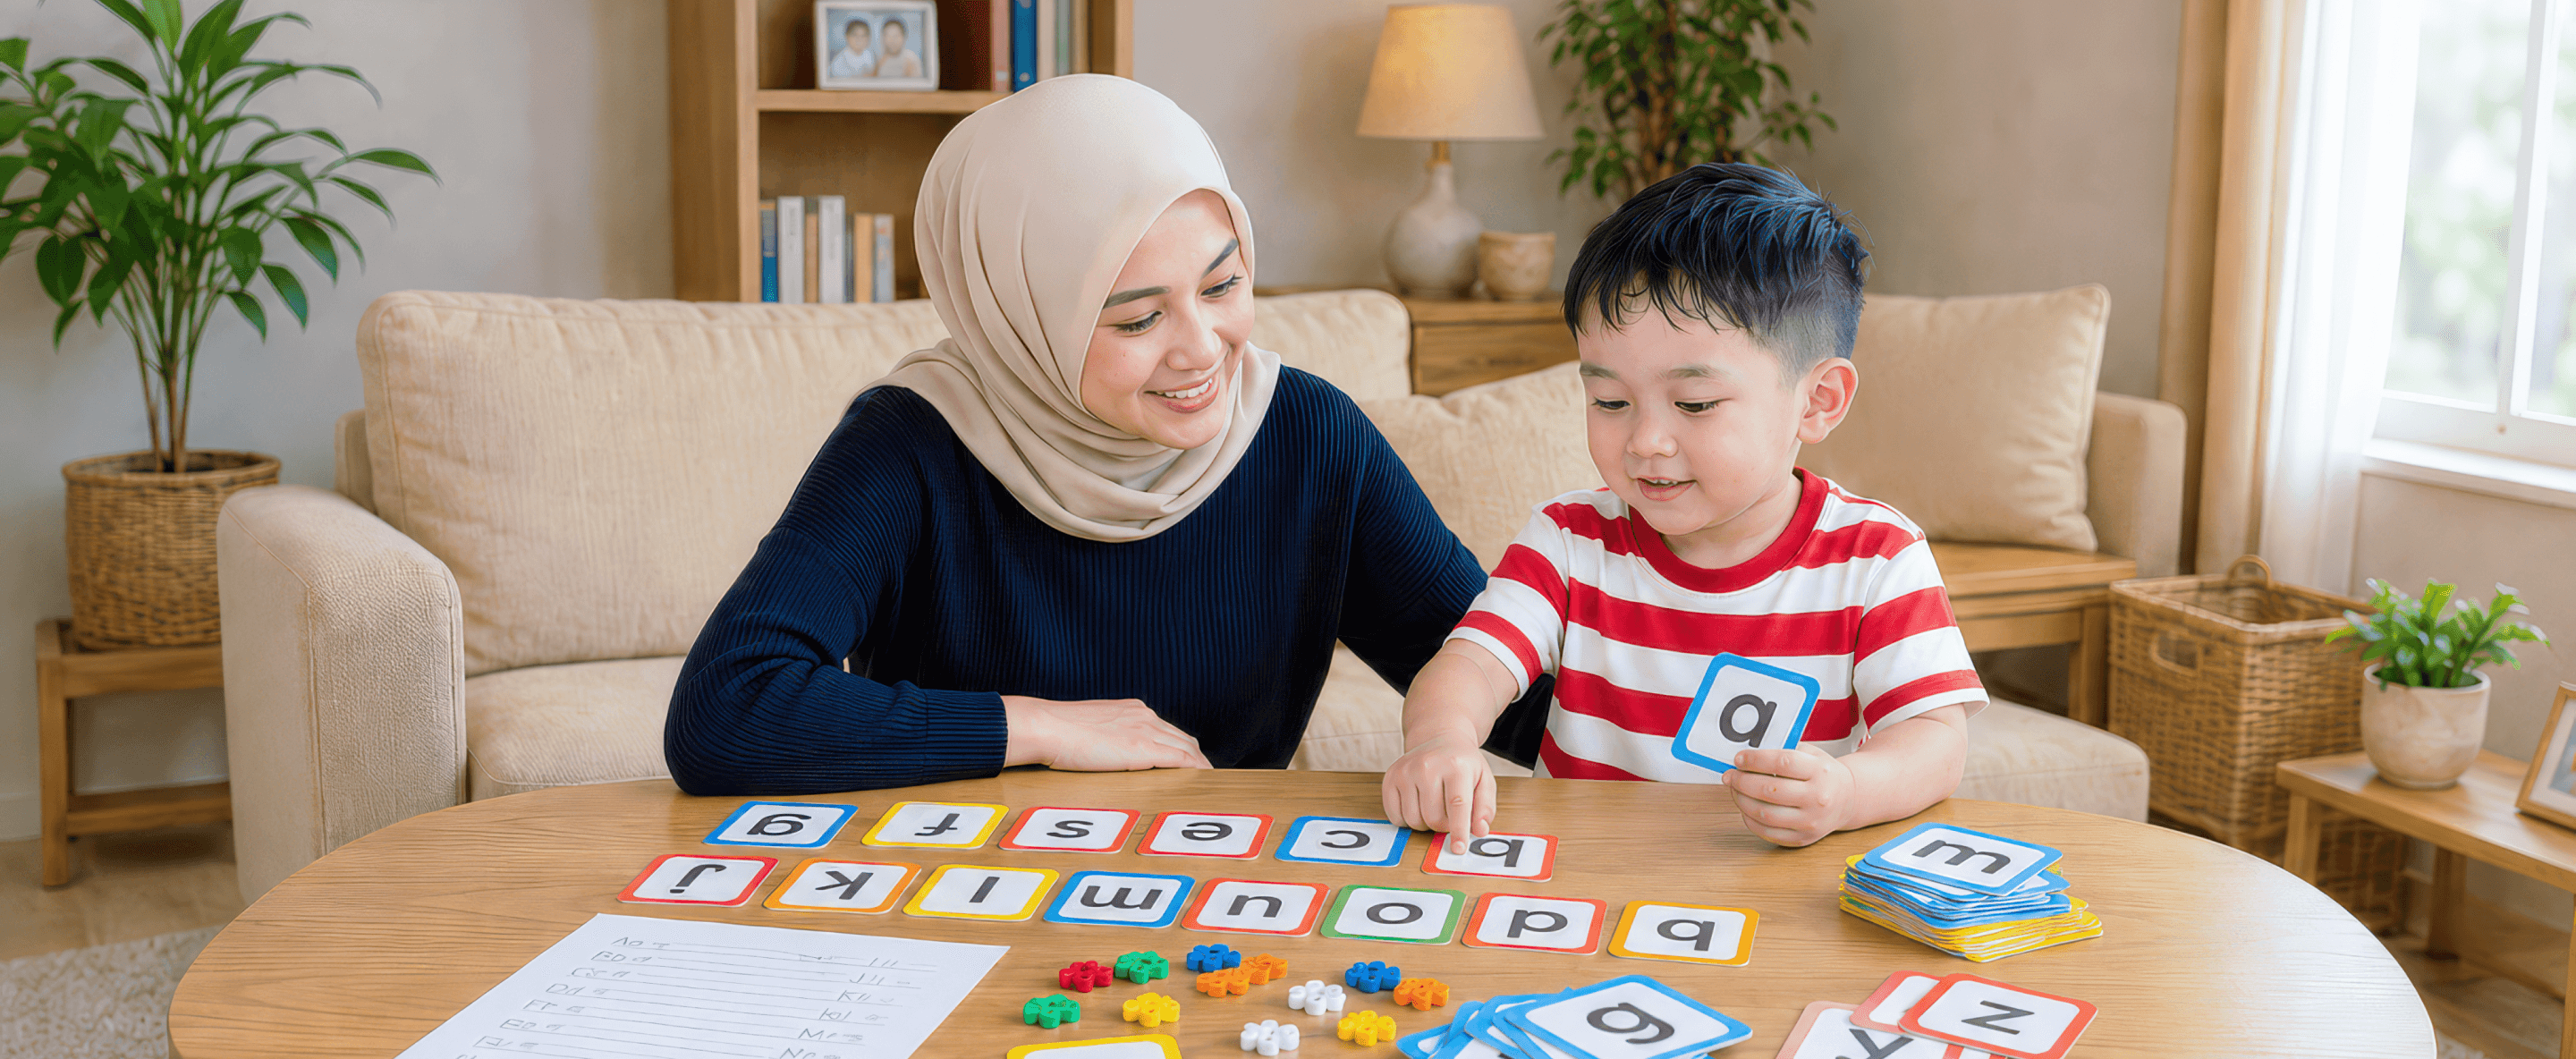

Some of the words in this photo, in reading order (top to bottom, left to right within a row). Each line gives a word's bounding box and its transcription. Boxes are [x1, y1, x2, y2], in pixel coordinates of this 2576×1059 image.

[1719, 694, 1777, 748] a
[914, 813, 961, 836] f
[1046, 820, 1093, 839] s
[1181, 821, 1233, 842] e
[1320, 830, 1370, 849] c
[1911, 840, 2011, 874] m
[670, 864, 726, 894] j
[815, 871, 873, 901] k
[1366, 902, 1424, 925] o
[1587, 1003, 1675, 1045] g
[1961, 1000, 2035, 1035] z
